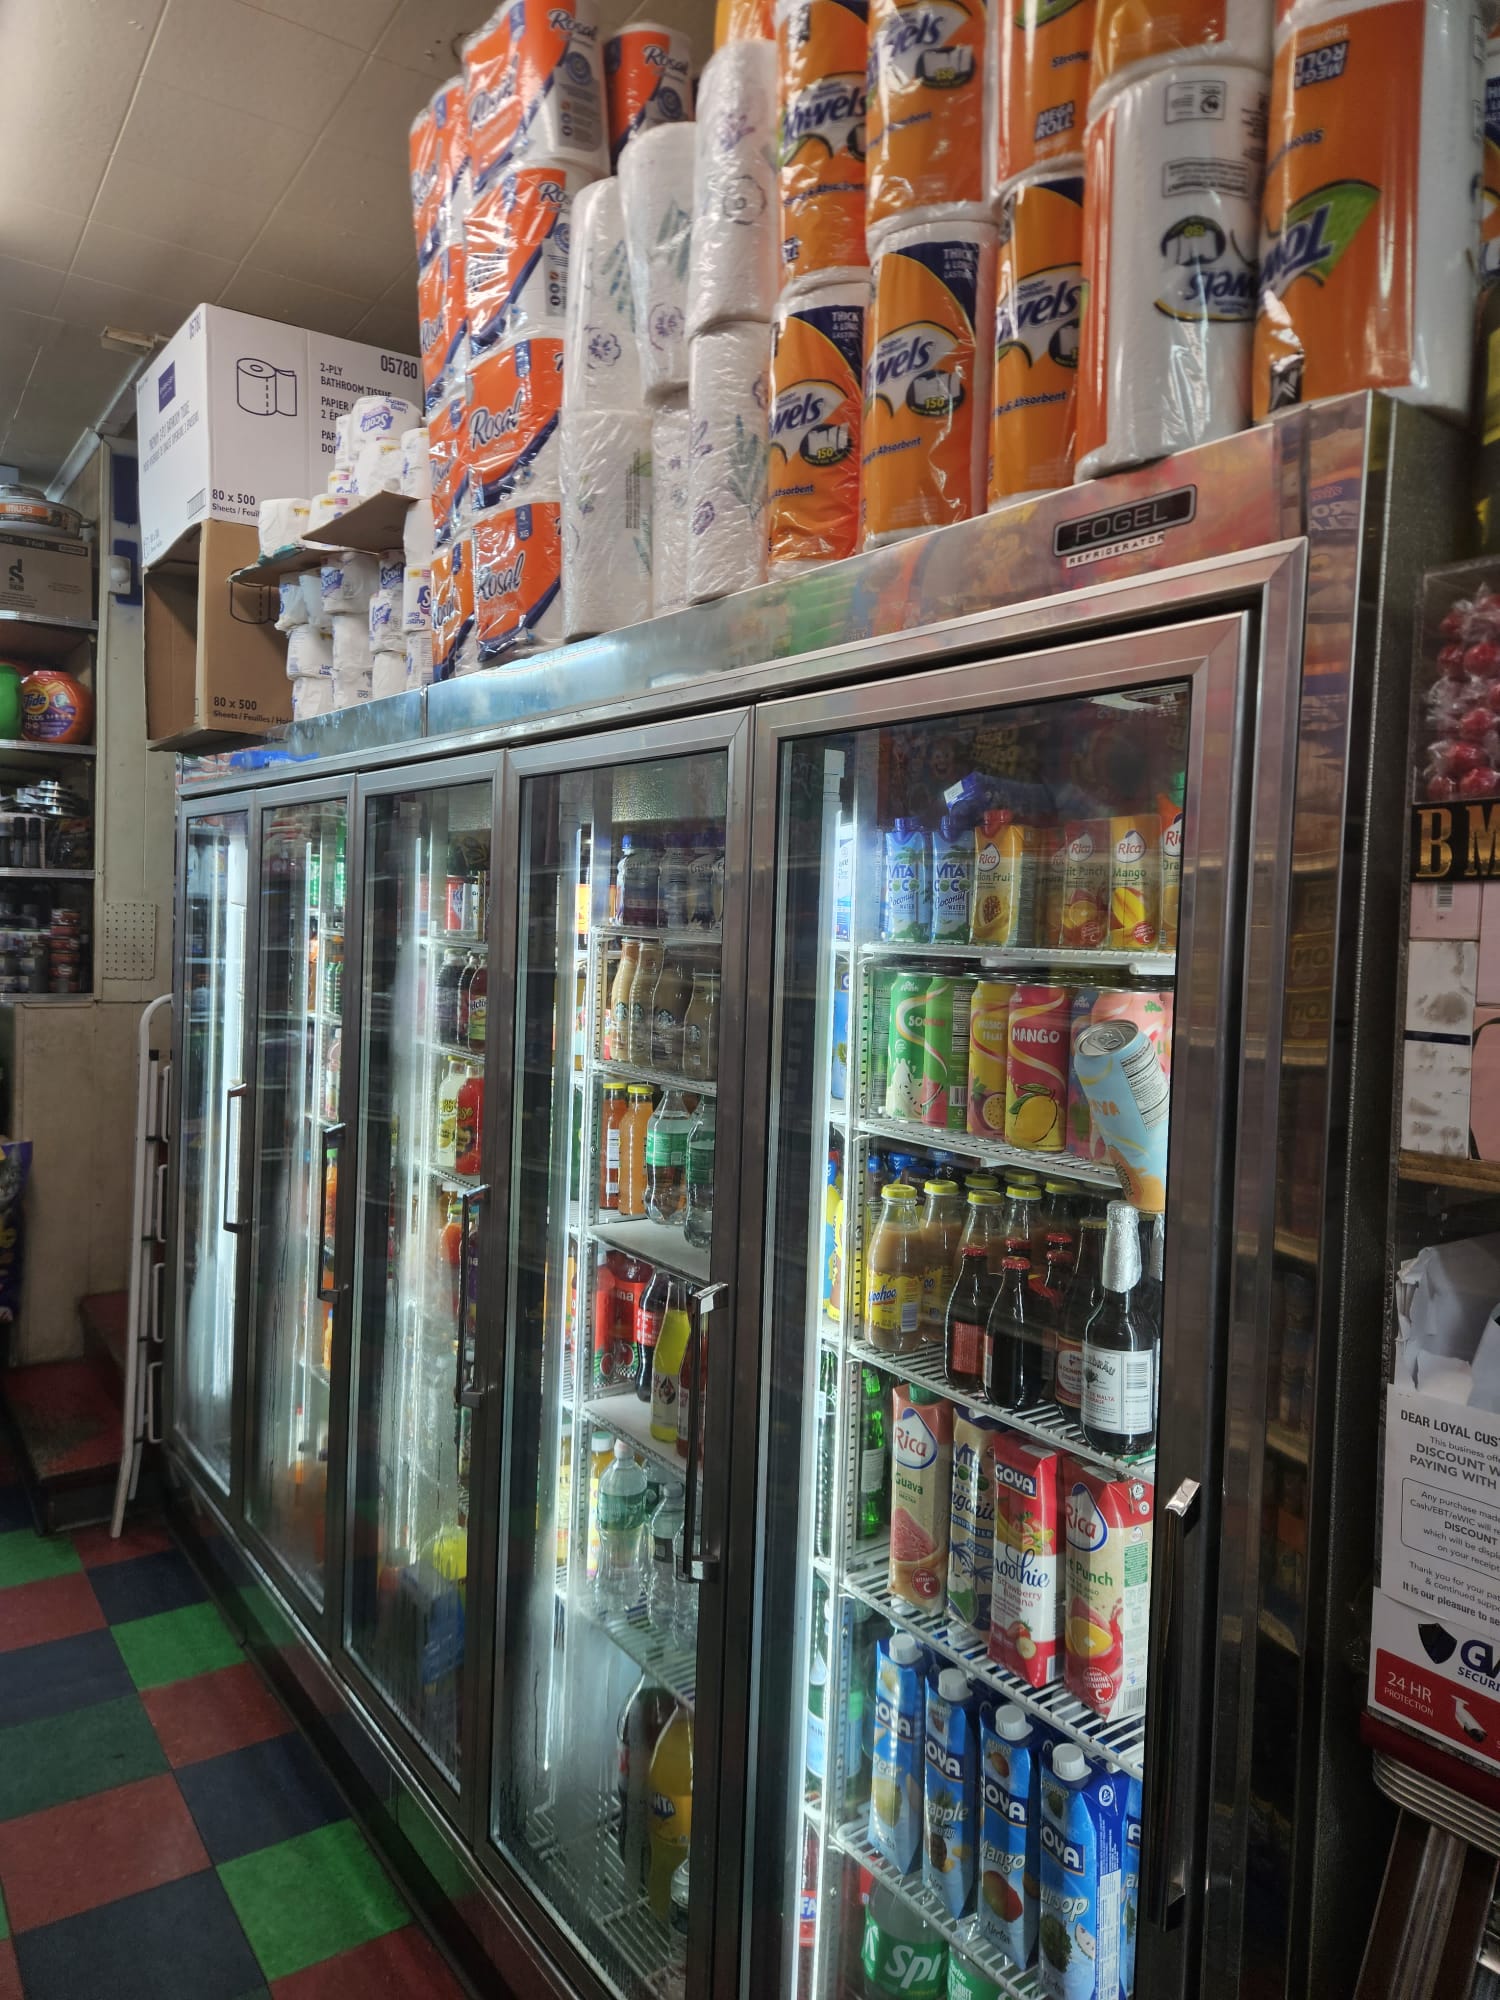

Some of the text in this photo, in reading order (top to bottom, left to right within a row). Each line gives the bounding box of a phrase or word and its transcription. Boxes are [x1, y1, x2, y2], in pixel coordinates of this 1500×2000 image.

[548, 9, 598, 38] Rosal
[644, 45, 689, 76] Rosal
[1295, 42, 1348, 70] ROLL
[1038, 101, 1075, 123] MEGA
[1036, 115, 1074, 140] ROLL
[320, 362, 343, 377] 2-PLY
[380, 354, 418, 380] 05780
[320, 376, 365, 395] BATHROOM
[321, 396, 349, 410] PAPIER
[321, 409, 327, 419] 2
[925, 397, 945, 409] 150
[364, 412, 391, 433] Scott
[470, 389, 525, 450] Rosal
[817, 448, 833, 460] 150
[879, 437, 922, 455] Absorbent
[212, 488, 256, 506] 80 x 500
[212, 503, 236, 515] Sheets
[1075, 502, 1169, 544] FOGEL
[1068, 533, 1166, 566] REFRIGERATOR
[477, 551, 525, 601] Rosal
[24, 692, 47, 707] Tide
[213, 696, 257, 711] 80 x 500
[213, 710, 238, 719] Sheets
[243, 713, 270, 723] Feuilles
[979, 853, 997, 865] Rica
[1071, 843, 1091, 854] Rica
[1118, 842, 1142, 855] Rica
[889, 863, 915, 879] VITA
[936, 862, 966, 879] VITA
[1112, 867, 1147, 880] Mango
[1011, 1027, 1060, 1044] MANGO
[1400, 1409, 1430, 1428] DEAR
[1433, 1419, 1471, 1440] LOYAL
[894, 1427, 928, 1458] Rica
[1429, 1436, 1447, 1448] This
[1448, 1441, 1485, 1459] business
[1416, 1443, 1486, 1472] DISCOUNT
[995, 1464, 1036, 1495] GOYA
[1409, 1454, 1497, 1490] PAYING WITH
[896, 1472, 924, 1496] Guava
[1421, 1491, 1438, 1503] Any
[1439, 1498, 1478, 1515] purchase
[1065, 1502, 1098, 1540] Rica
[1409, 1498, 1492, 1532] Cash/EBT/eWIC will
[1423, 1528, 1476, 1551] which will be
[1444, 1520, 1499, 1546] DISCOUNT
[1437, 1545, 1448, 1553] on
[1449, 1549, 1469, 1561] your
[997, 1574, 1043, 1600] Strawberry
[1076, 1564, 1114, 1587] Punch
[1408, 1560, 1433, 1576] Thank
[1435, 1571, 1451, 1582] you
[1452, 1576, 1465, 1586] for
[1466, 1583, 1485, 1595] your
[923, 1583, 931, 1593] C
[1424, 1577, 1431, 1585] &
[1433, 1582, 1475, 1602] continued
[1402, 1581, 1409, 1591] It
[1410, 1584, 1419, 1595] is
[1420, 1590, 1436, 1601] our
[1437, 1596, 1476, 1617] pleasure
[1478, 1611, 1488, 1621] to
[1095, 1689, 1105, 1701] C
[1387, 1671, 1432, 1704] 24 HR
[1384, 1687, 1434, 1717] PROTECTION
